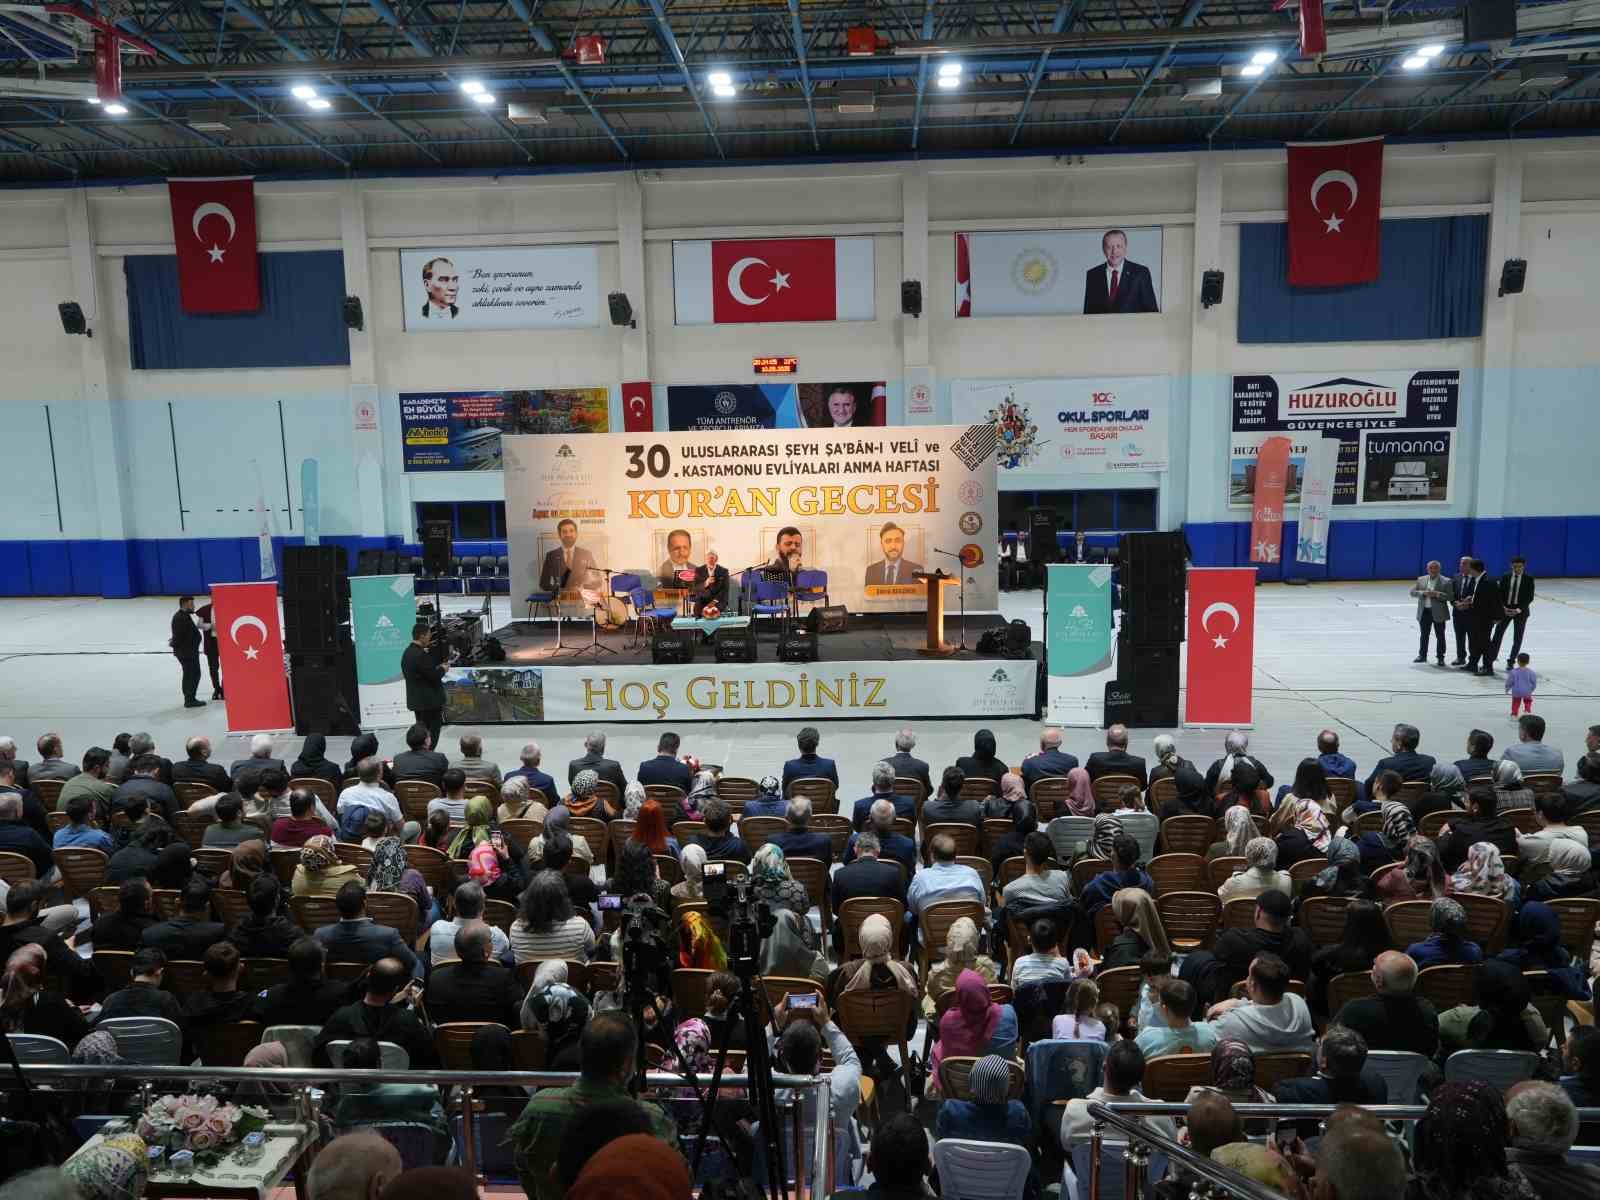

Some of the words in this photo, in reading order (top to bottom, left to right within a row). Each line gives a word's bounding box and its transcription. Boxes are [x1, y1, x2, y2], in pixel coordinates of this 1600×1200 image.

[1288, 389, 1397, 409] HUZUROĞLU
[403, 406, 415, 414] EN
[416, 404, 447, 414] BÜYÜK
[1058, 411, 1089, 422] OKUL
[1091, 409, 1149, 422] SPORLARI
[696, 416, 714, 425] TÜM
[716, 415, 757, 424] ANTRENÖR
[1287, 419, 1397, 430] GÜVENCESİYLE
[1089, 432, 1118, 440] BAŞARI
[681, 443, 779, 459] ULUSLARARASI
[785, 443, 819, 458] ŞEYH
[825, 440, 883, 456] ŞA'BÂN-I
[890, 438, 918, 454] VELÎ
[925, 443, 940, 453] ve
[1368, 440, 1445, 454] tumanna
[682, 463, 762, 477] KASTAMONU
[766, 460, 840, 476] EVLİYALARI
[843, 460, 882, 474] ANMA
[885, 459, 940, 473] HAFTASI
[789, 476, 941, 515] GECESİ
[686, 671, 888, 710] GELDİNİZ
